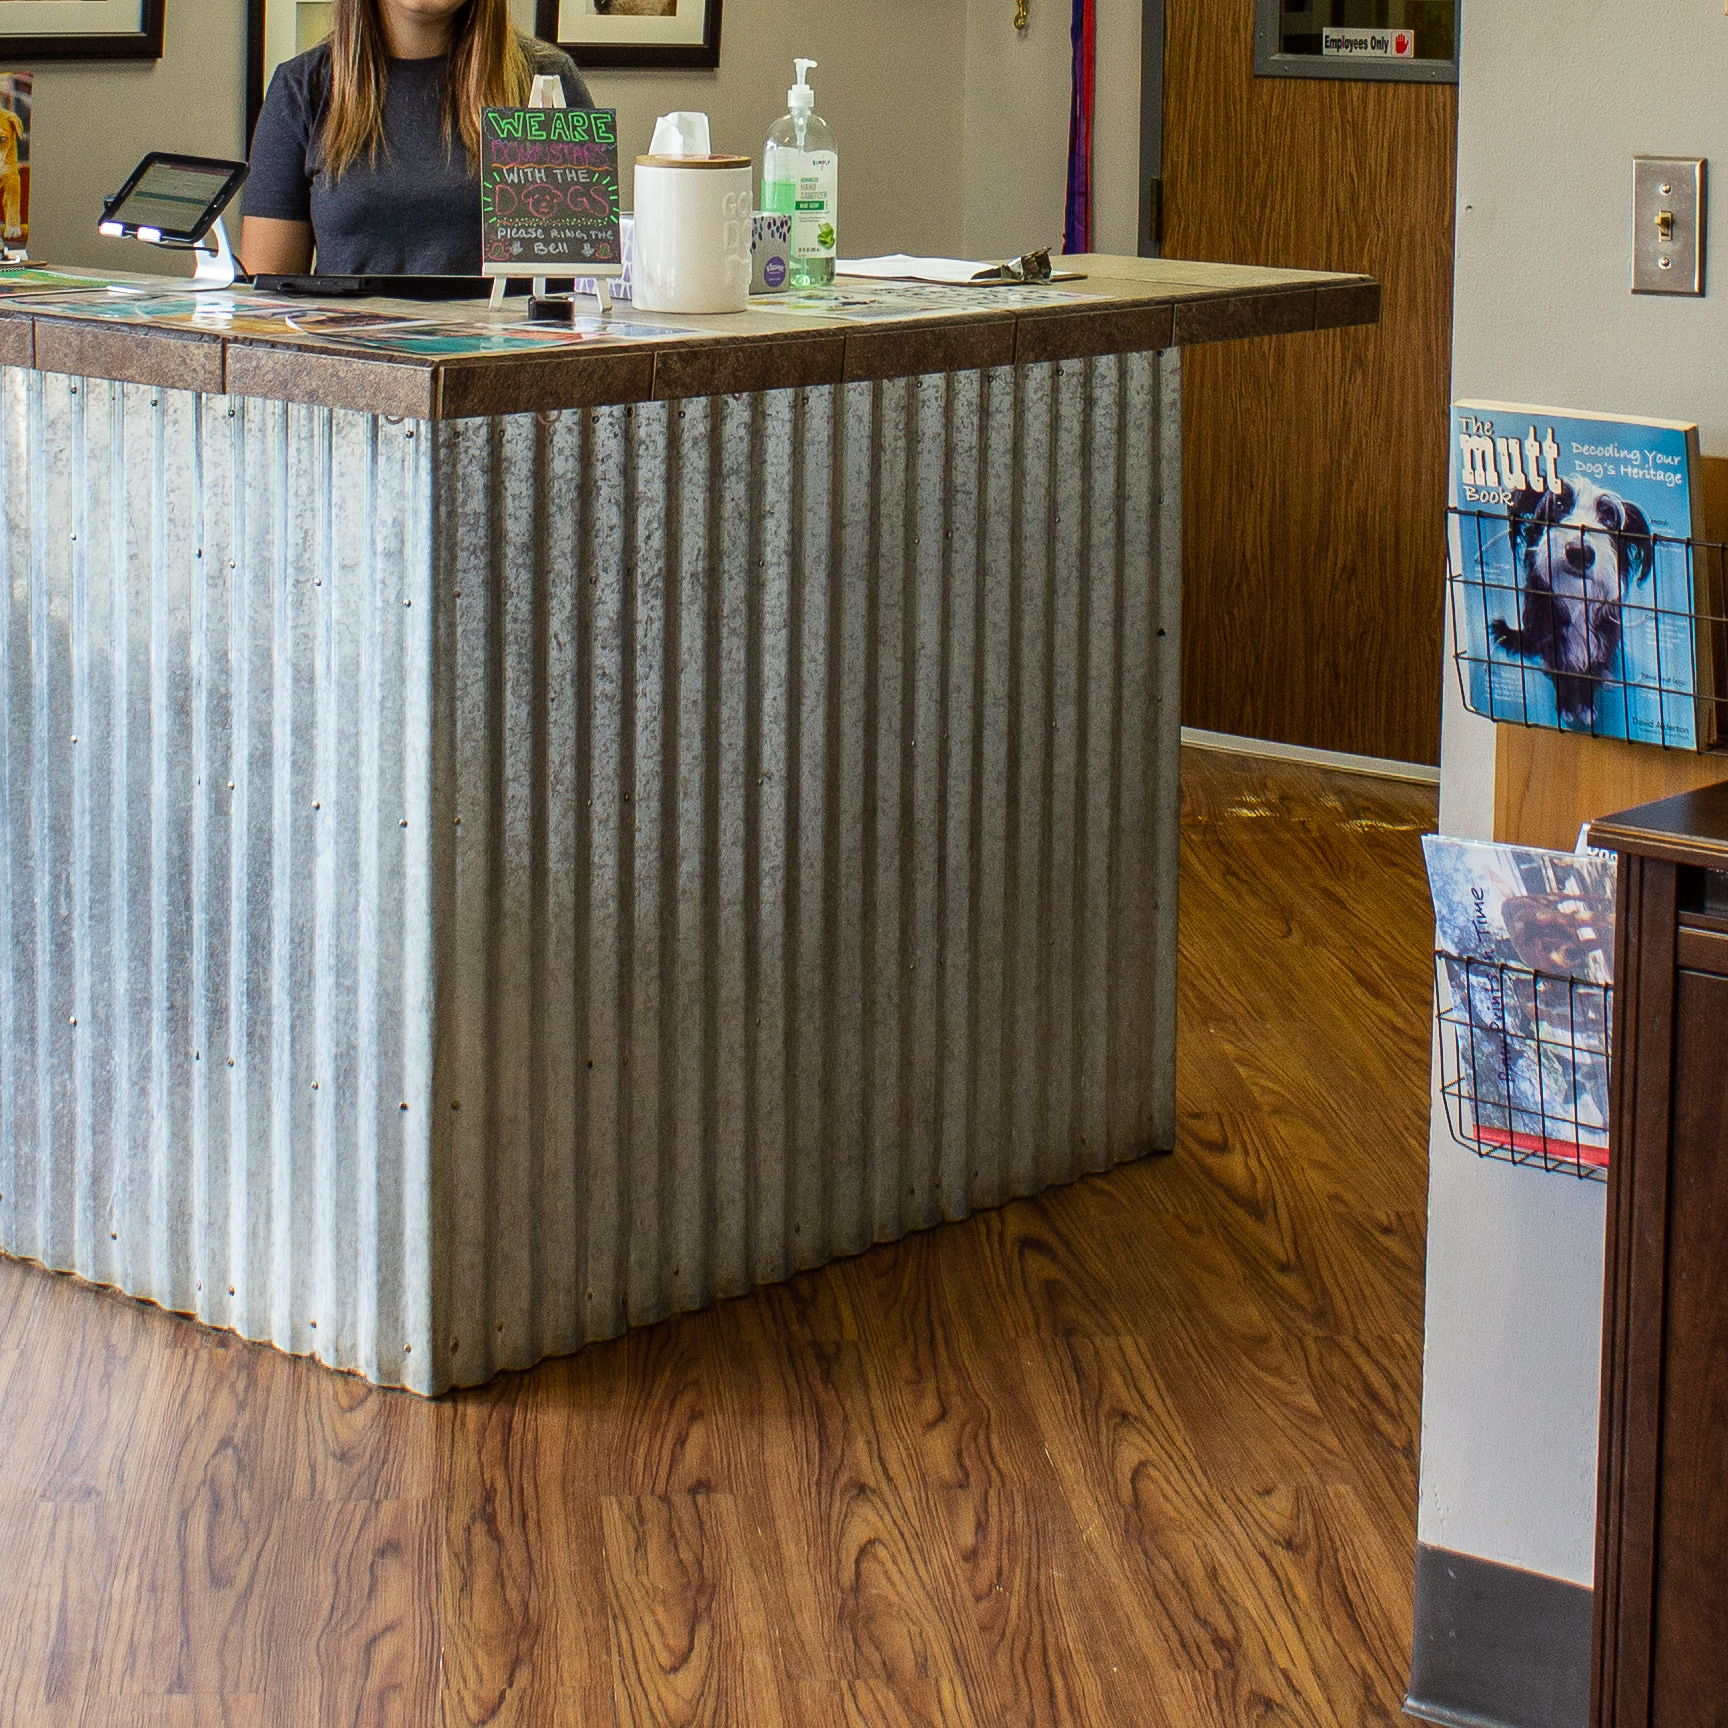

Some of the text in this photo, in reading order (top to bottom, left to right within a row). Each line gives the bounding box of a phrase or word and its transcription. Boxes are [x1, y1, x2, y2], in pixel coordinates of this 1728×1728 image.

[1324, 34, 1389, 54] Employees Only
[503, 167, 590, 184] WITH THE
[533, 242, 569, 255] Bell
[1458, 416, 1494, 436] The
[1459, 425, 1563, 495] mutt
[1571, 442, 1682, 467] Decoding Your
[1575, 460, 1683, 487] Dog's Heritage
[1462, 485, 1515, 506] Book
[1471, 885, 1485, 944] Time
